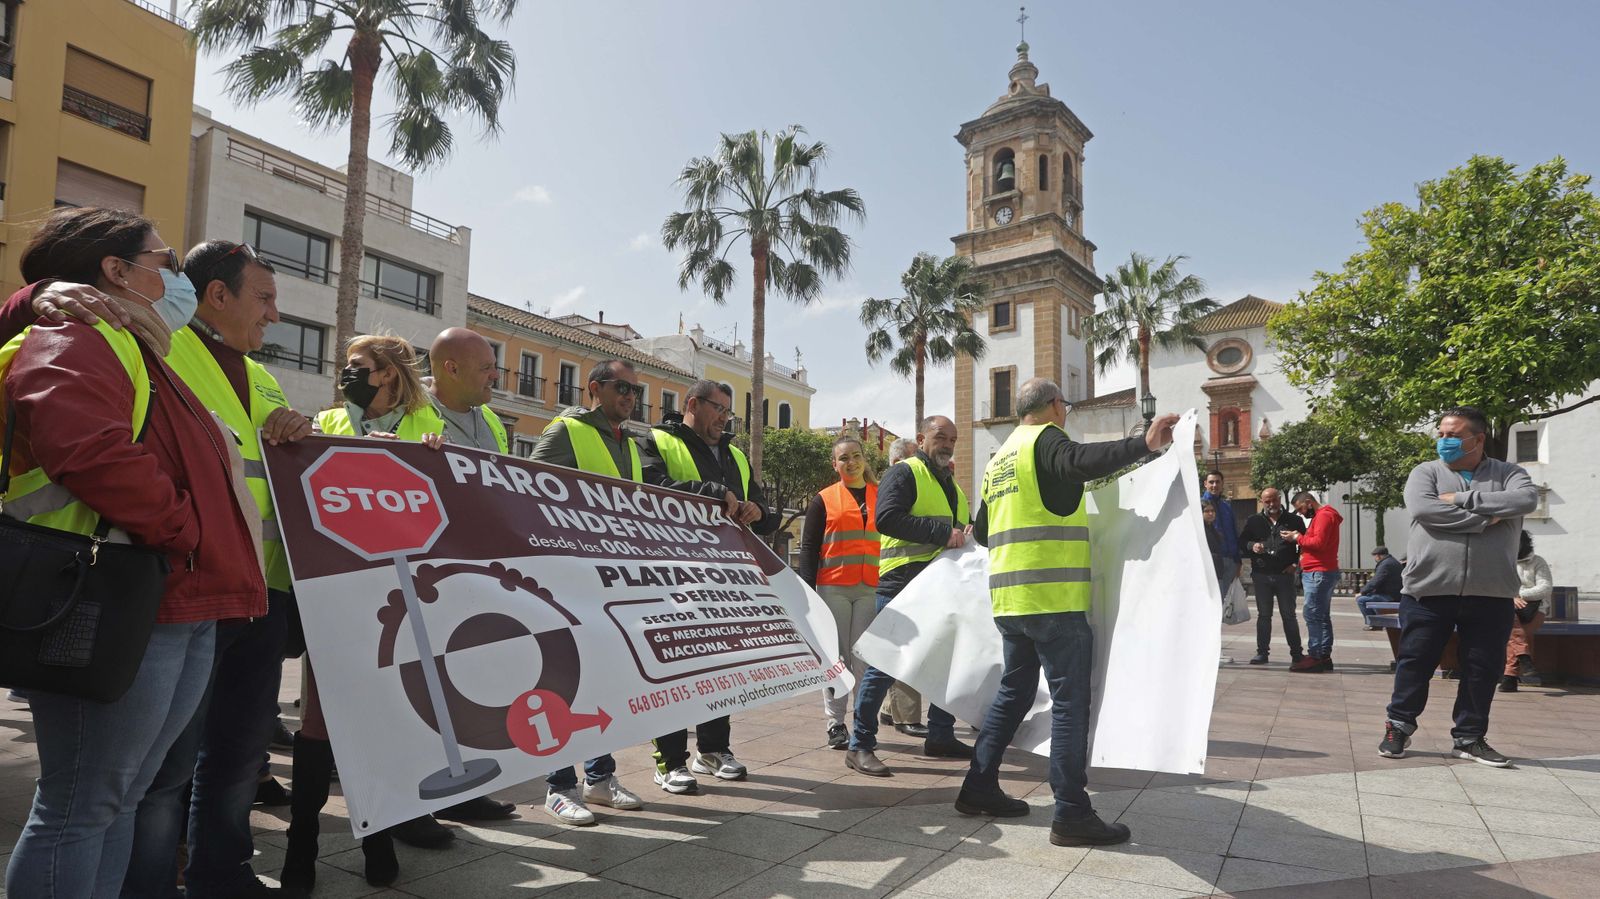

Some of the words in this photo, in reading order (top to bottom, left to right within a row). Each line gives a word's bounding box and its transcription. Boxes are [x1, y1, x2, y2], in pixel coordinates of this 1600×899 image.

[319, 486, 430, 514] STOP
[444, 451, 569, 502] PARO
[577, 479, 741, 529] NACIONA
[538, 503, 720, 544] INDEFINIDO
[528, 533, 577, 550] desde
[577, 539, 602, 553] las
[600, 539, 645, 556] 00h
[645, 546, 667, 557] del
[662, 546, 691, 558] 14
[691, 549, 707, 558] de
[702, 547, 756, 561] Marzo
[669, 589, 754, 604] DEFENSA
[641, 611, 698, 625] SECTOR
[653, 632, 671, 643] de
[672, 625, 743, 641] MERCANCIAS
[745, 625, 761, 636] por
[661, 640, 732, 660] NACIONAL
[740, 632, 805, 648] INTERNACIO
[628, 694, 651, 715] 648
[650, 688, 670, 708] 057
[670, 684, 691, 702] 615
[695, 679, 715, 696] 659
[713, 675, 732, 691] 165
[729, 671, 747, 688] 710
